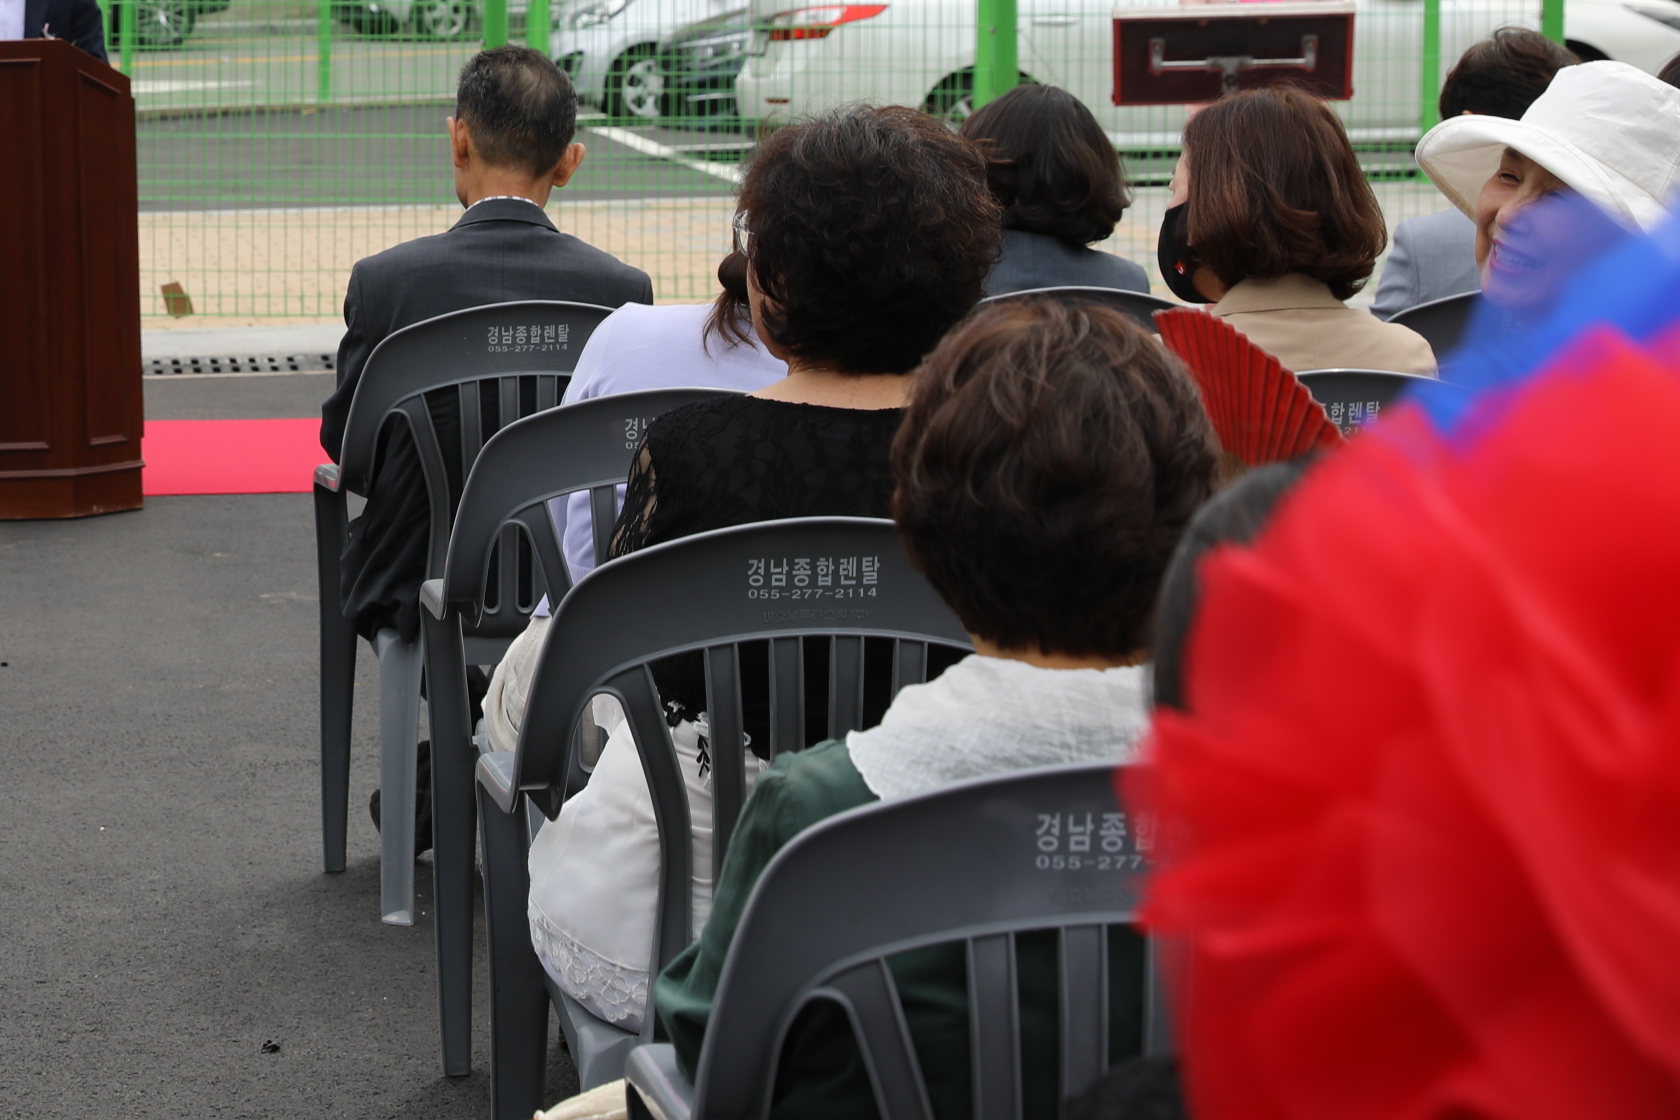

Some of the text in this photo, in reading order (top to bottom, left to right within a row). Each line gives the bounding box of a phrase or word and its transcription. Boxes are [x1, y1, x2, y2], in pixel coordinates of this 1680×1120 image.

[487, 324, 569, 345] 경남종합렌탈
[488, 343, 568, 353] 055-277-2114
[1320, 401, 1380, 425] 합렌탈
[747, 556, 880, 586] 경남종합렌탈
[748, 587, 878, 599] 055-277-2114
[1035, 812, 1160, 852] 경남종합
